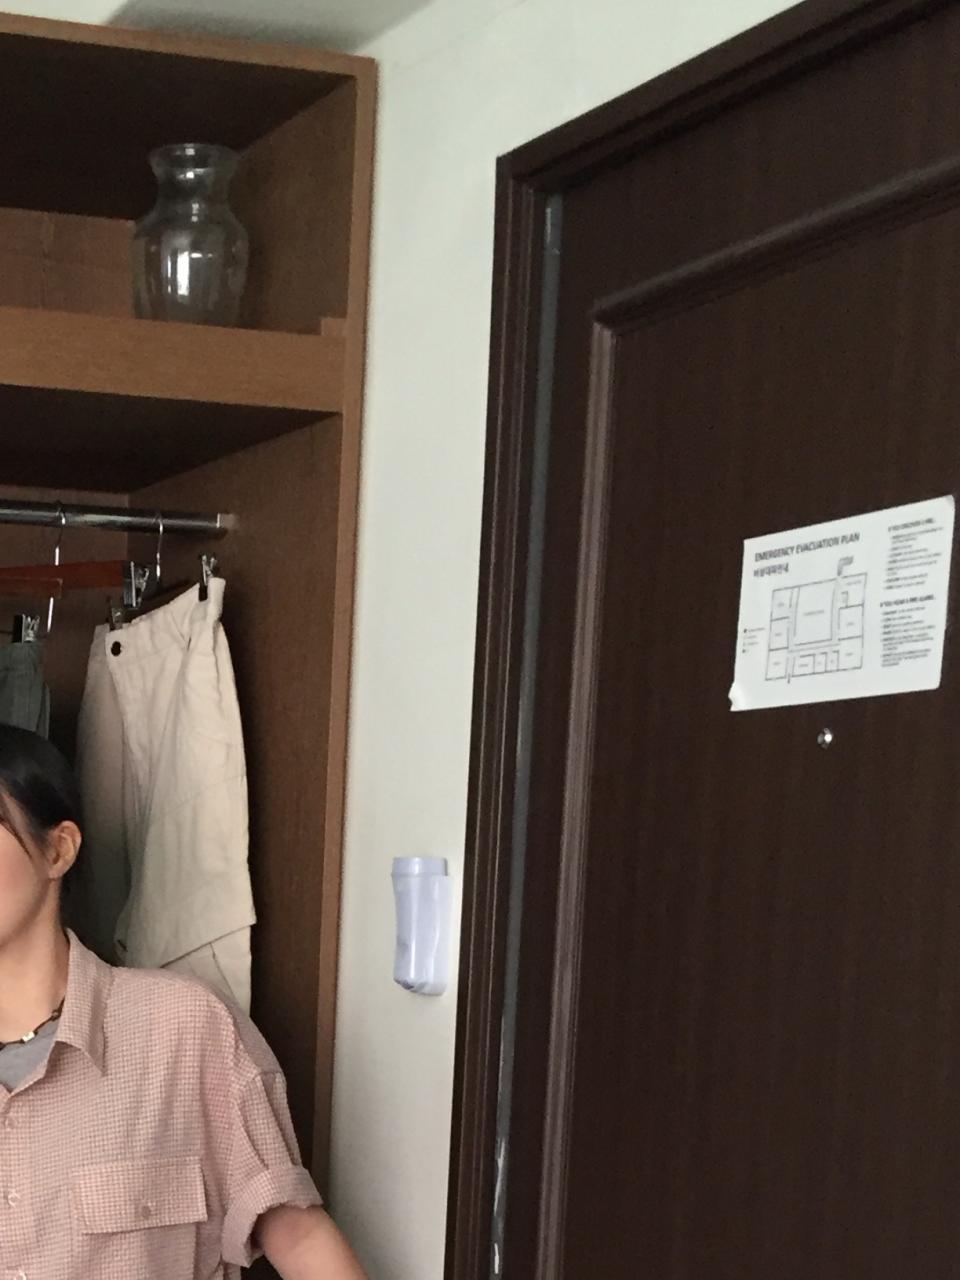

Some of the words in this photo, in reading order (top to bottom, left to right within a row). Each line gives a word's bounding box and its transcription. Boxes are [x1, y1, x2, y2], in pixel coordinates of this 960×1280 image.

[755, 545, 795, 562] EMERGENCY
[796, 537, 840, 554] EVACUATION
[841, 532, 860, 545] PLAN
